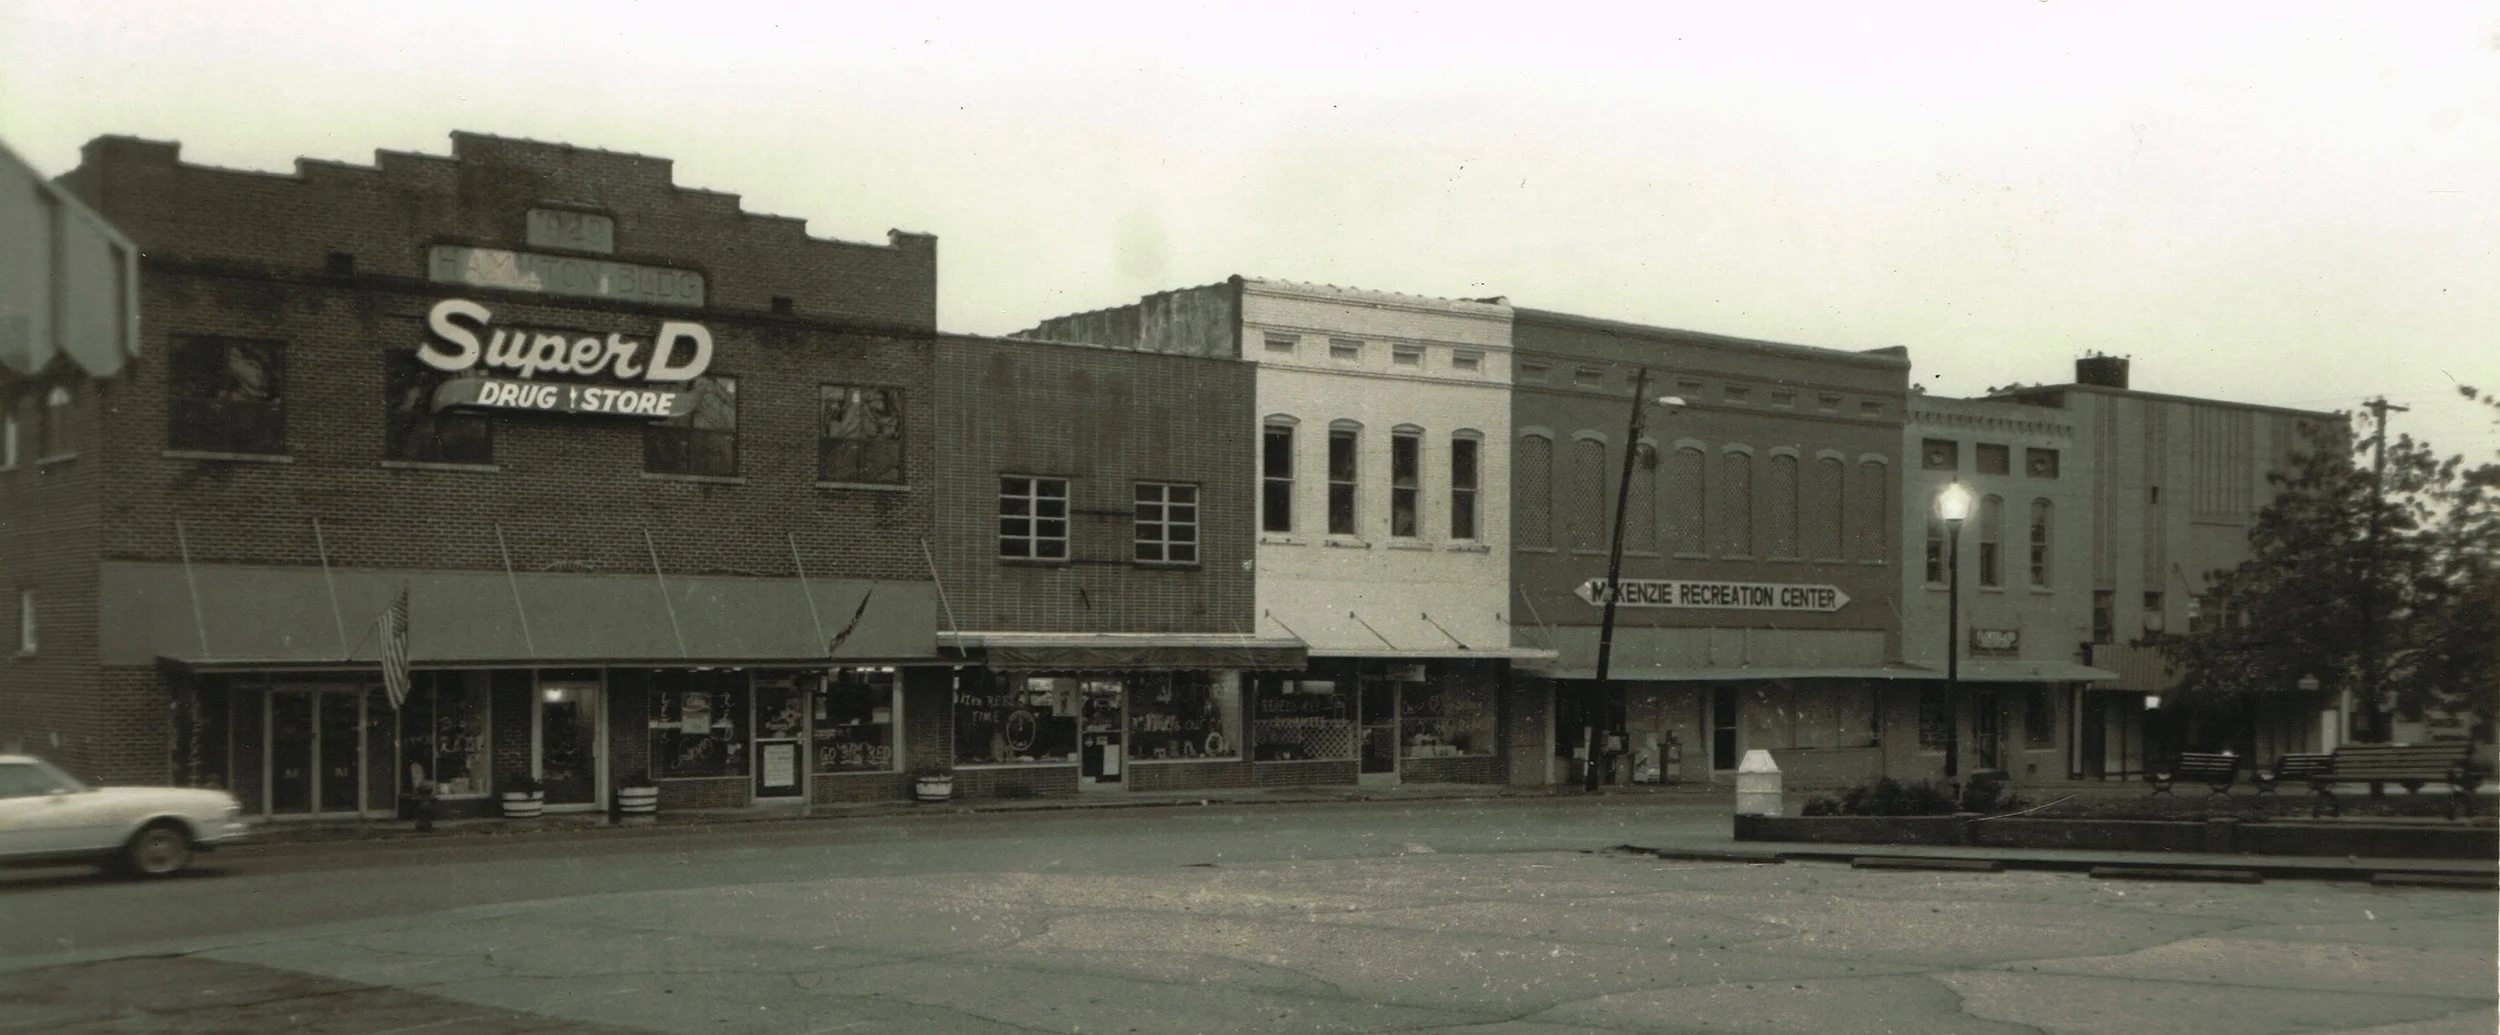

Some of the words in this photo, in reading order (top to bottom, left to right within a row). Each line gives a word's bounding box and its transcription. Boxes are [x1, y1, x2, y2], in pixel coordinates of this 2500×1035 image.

[417, 298, 643, 380] Super
[644, 321, 713, 382] D
[478, 381, 557, 408] DRUG
[581, 388, 676, 416] STORE
[1592, 581, 1672, 605] MKENZIE
[1680, 584, 1774, 607] RECREATION
[1780, 586, 1837, 608] CENTER
